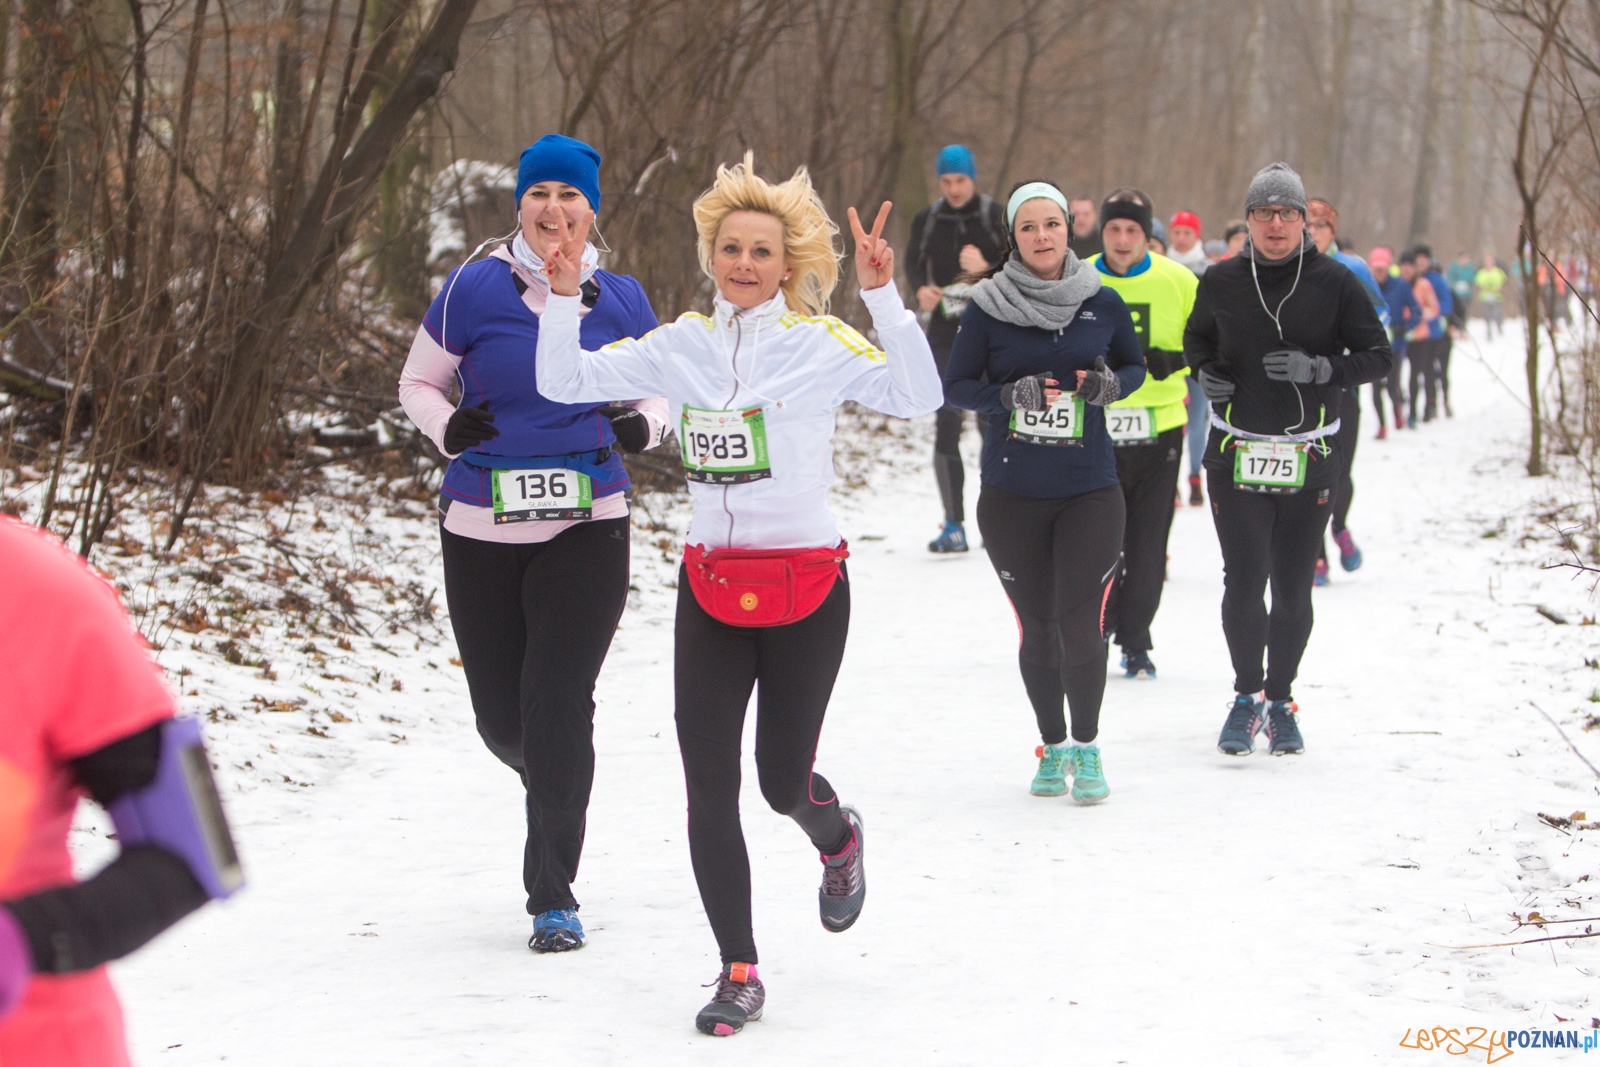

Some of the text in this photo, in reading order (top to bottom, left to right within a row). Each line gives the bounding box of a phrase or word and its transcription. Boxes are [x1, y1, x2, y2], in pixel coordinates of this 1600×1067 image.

[1024, 408, 1069, 428] 645
[1111, 415, 1141, 432] 271
[689, 432, 748, 459] 1983
[1248, 457, 1293, 477] 1775
[515, 472, 567, 499] 136
[528, 500, 558, 509] SŁAWKA
